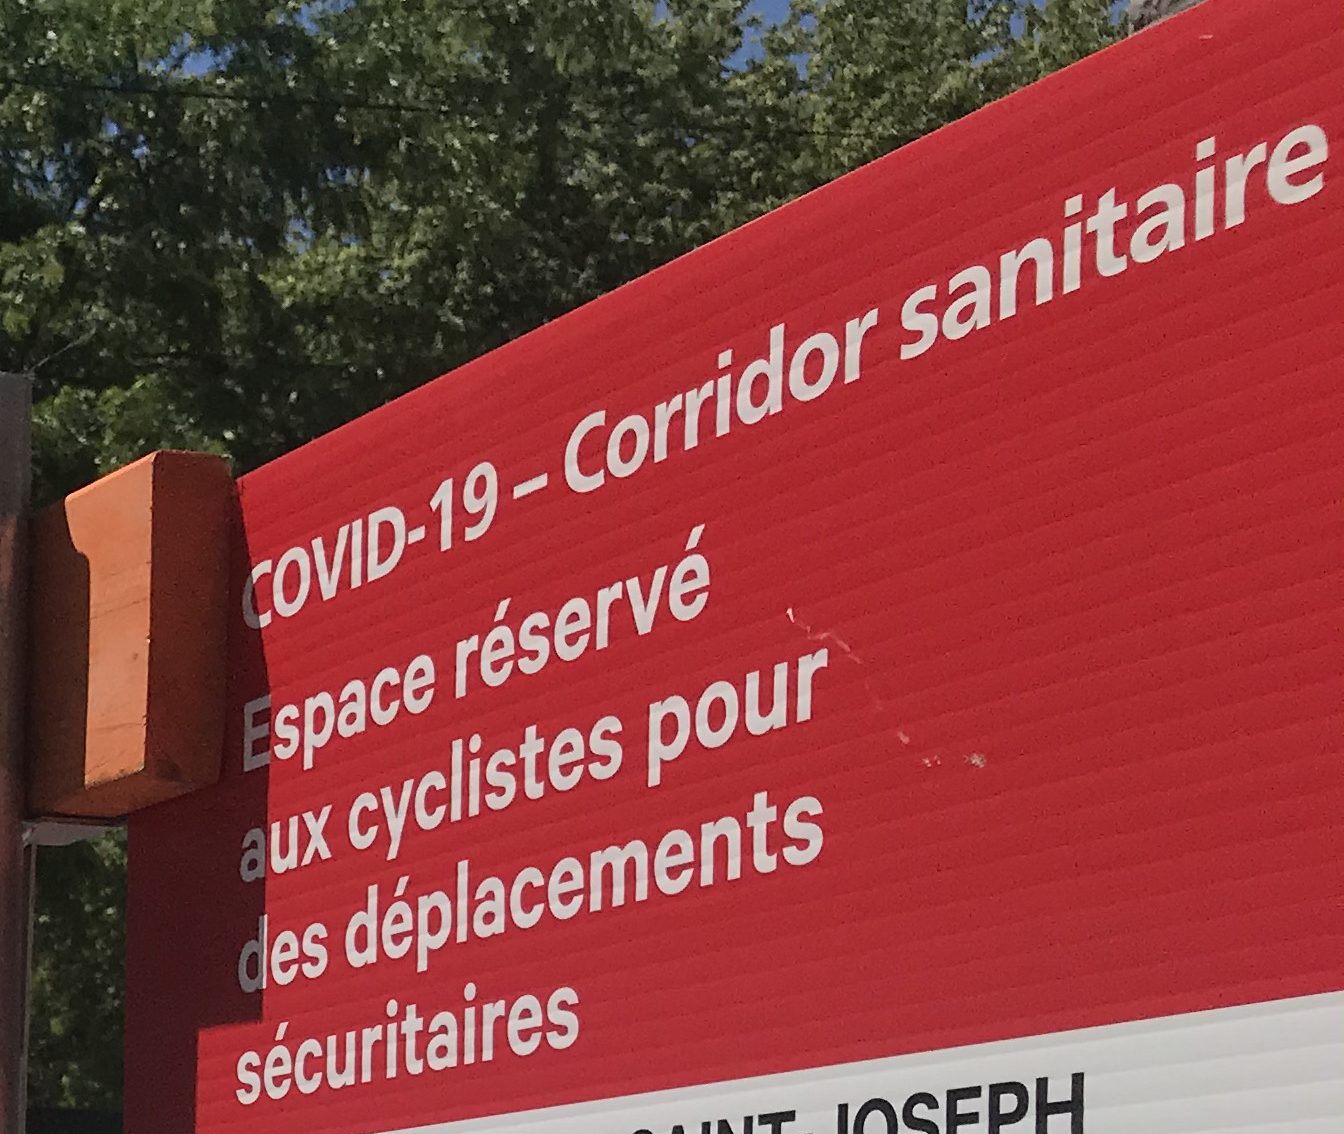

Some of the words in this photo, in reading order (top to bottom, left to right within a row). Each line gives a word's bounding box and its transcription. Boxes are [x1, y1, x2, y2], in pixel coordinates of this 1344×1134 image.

[243, 462, 497, 628] COVID-19
[565, 308, 878, 492] Corridor
[900, 124, 1328, 360] sanitaire
[243, 655, 435, 771] Espace
[456, 524, 710, 698] réservé
[240, 805, 332, 881] aux
[349, 716, 622, 859] cyclistes
[648, 648, 828, 787] pour
[238, 914, 328, 993] des
[345, 792, 823, 971] déplacements
[236, 983, 579, 1104] sécuritaires
